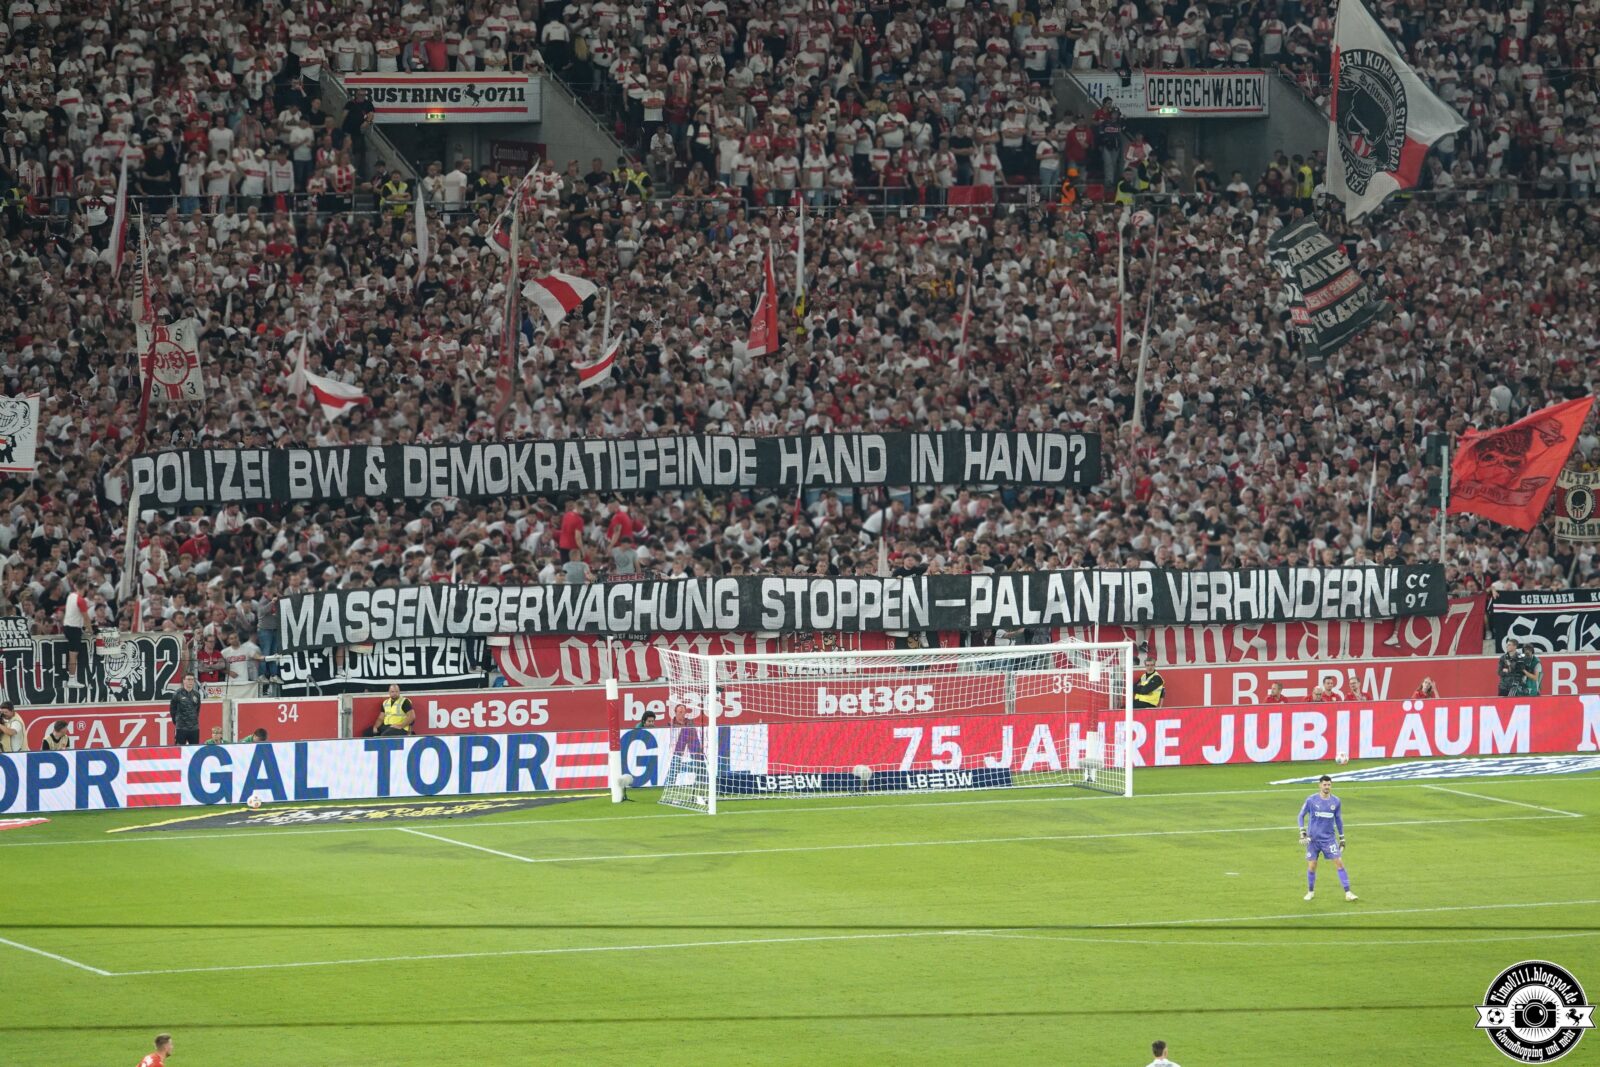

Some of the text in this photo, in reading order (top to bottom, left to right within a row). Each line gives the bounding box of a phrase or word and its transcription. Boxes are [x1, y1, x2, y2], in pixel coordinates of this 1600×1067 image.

[484, 86, 525, 102] 0711
[1149, 78, 1262, 107] OBERSCHWABEN
[132, 433, 1087, 503] POLIZEI BW & DEMOKRATIEFEINDE HAND IN HAND?
[1406, 574, 1432, 588] CC
[279, 578, 740, 651] MASSENÜBERWACHUNG
[1167, 567, 1397, 621] VERHINDERN!
[1405, 593, 1430, 608] 97
[1520, 593, 1575, 604] SCHWABEN
[277, 704, 299, 723] 34
[428, 699, 549, 728] bet365
[816, 687, 935, 714] bet365
[892, 726, 962, 771] 75
[1202, 700, 1530, 763] JUBILÄUM
